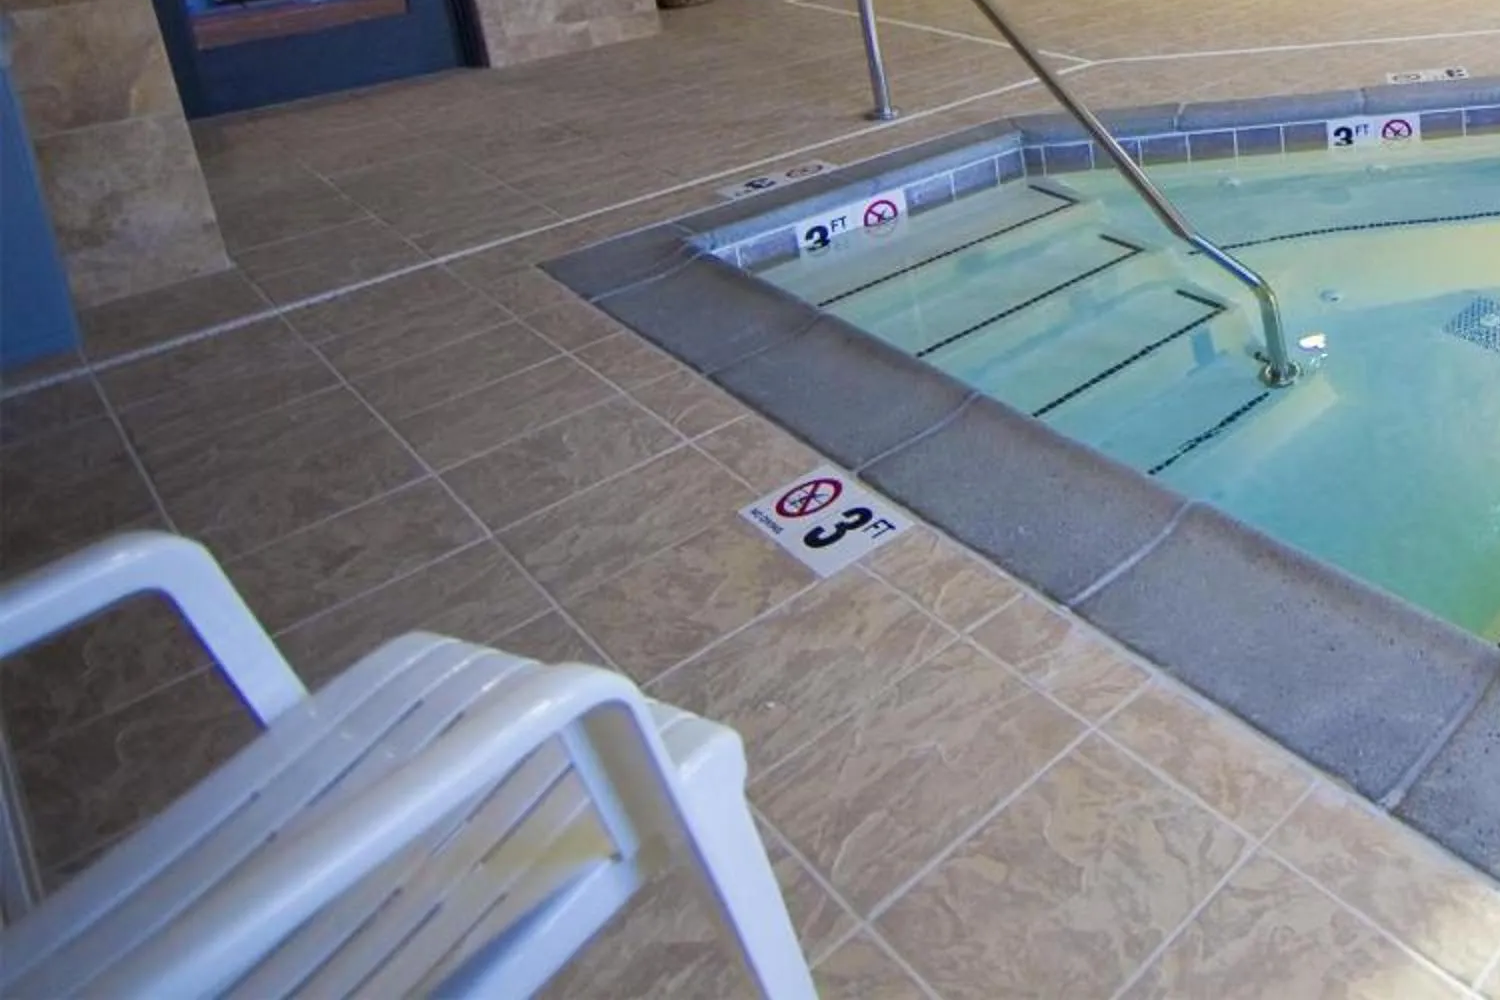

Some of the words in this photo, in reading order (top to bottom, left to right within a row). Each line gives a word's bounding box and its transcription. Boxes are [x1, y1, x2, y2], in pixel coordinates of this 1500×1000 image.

[1333, 126, 1353, 147] 3
[1355, 124, 1369, 137] FT
[805, 225, 831, 253] 3
[830, 216, 847, 232] FT
[803, 507, 873, 548] 3
[861, 519, 896, 539] FT
